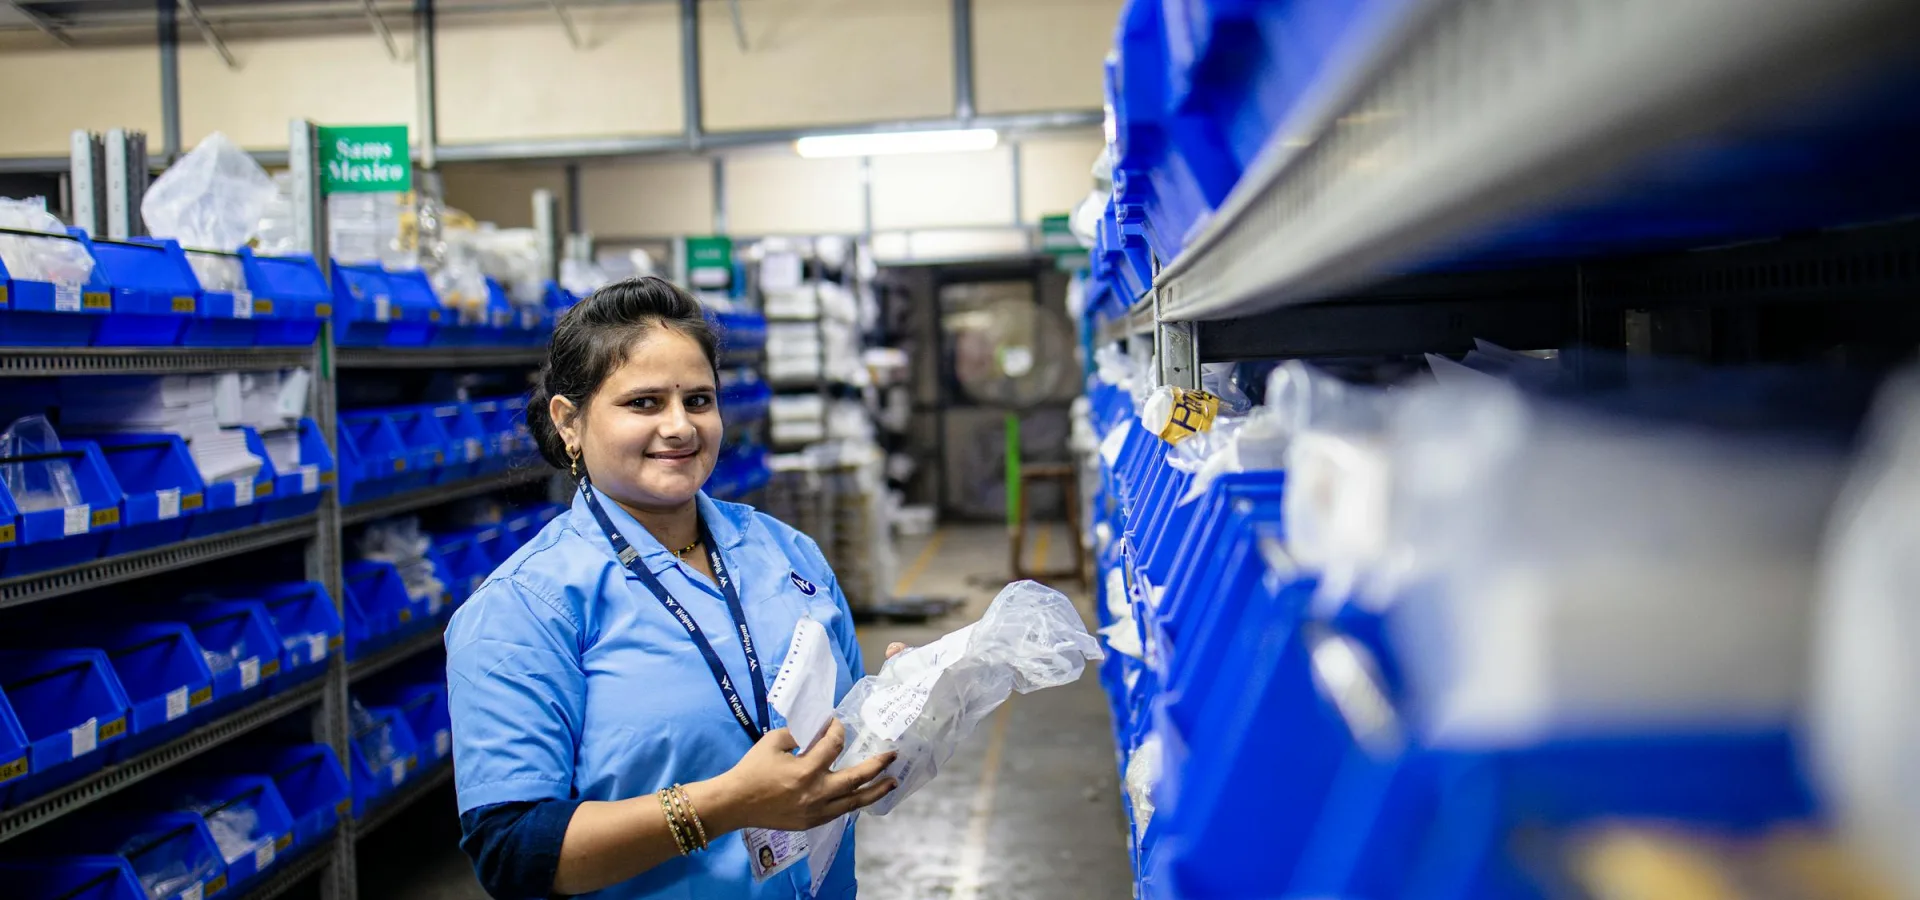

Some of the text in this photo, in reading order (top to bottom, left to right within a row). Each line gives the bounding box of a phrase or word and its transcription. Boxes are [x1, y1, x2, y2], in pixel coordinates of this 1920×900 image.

[335, 137, 393, 159] Sams
[327, 159, 404, 182] Mexico
[675, 607, 696, 632] Welspun
[739, 624, 753, 654] Welspun
[729, 693, 750, 726] Welspun
